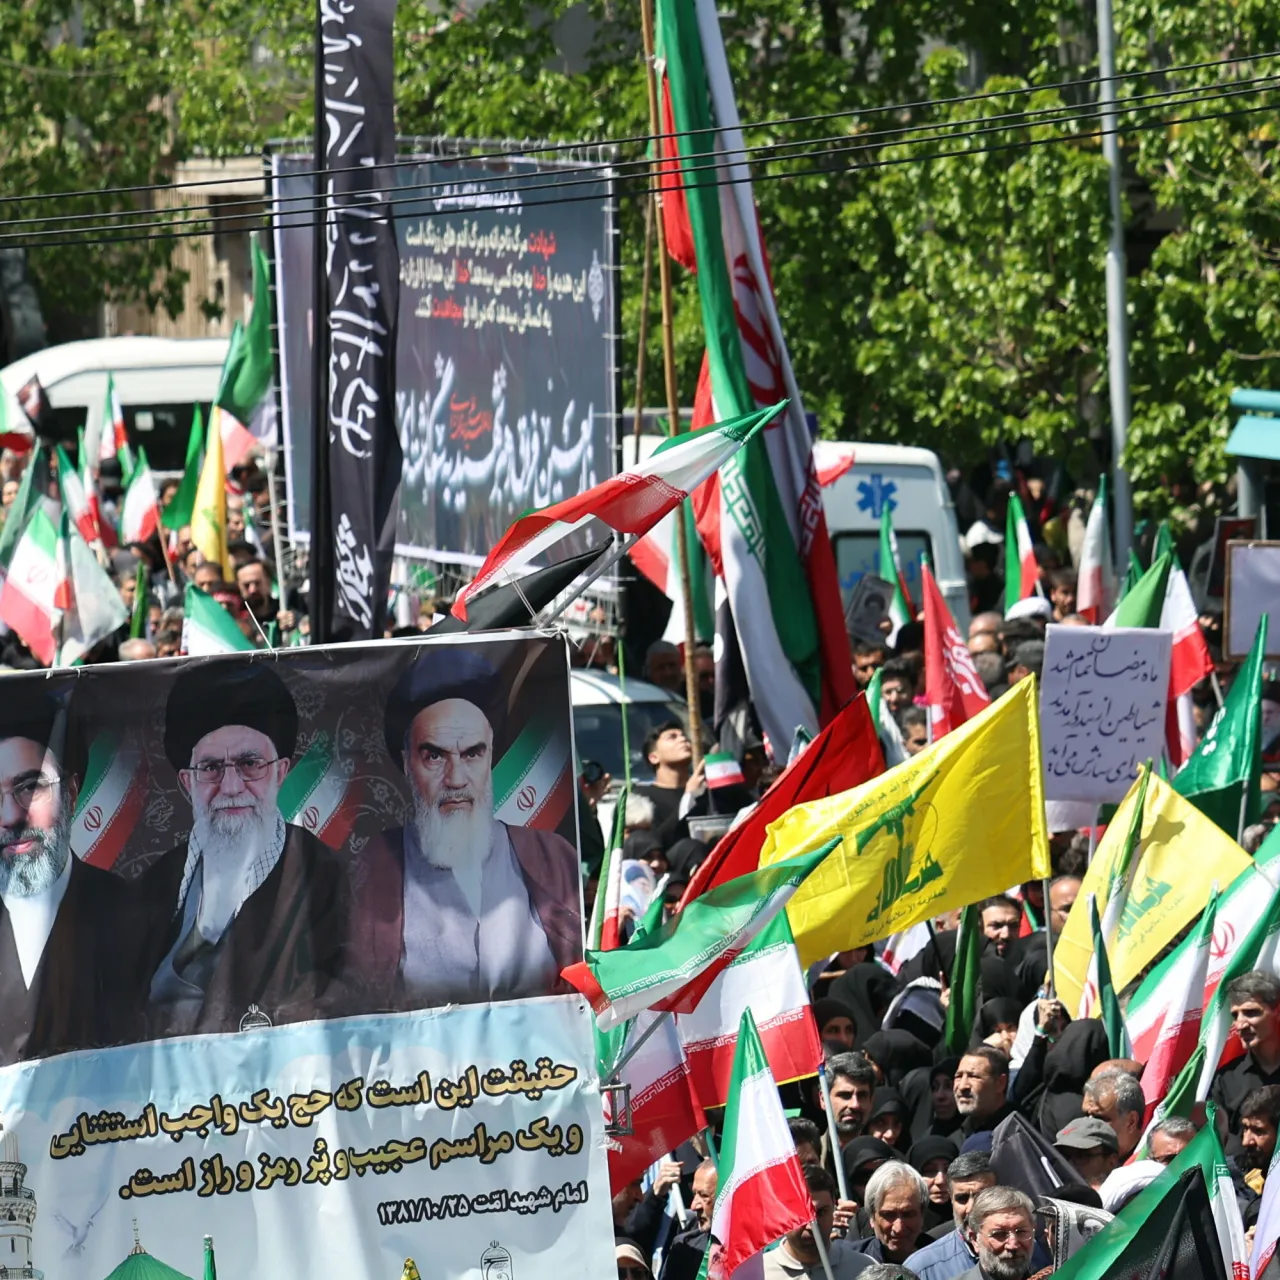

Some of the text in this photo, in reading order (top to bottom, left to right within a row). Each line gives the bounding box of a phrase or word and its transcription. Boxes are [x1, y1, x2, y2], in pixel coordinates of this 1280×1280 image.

[528, 229, 557, 261] شهادت
[456, 259, 469, 284] خدا
[532, 264, 547, 291] خدا
[1091, 636, 1147, 681] رمضان
[1142, 664, 1158, 683] ماه
[1098, 700, 1161, 742] شیاطین
[50, 1057, 577, 1159] حقیقت این است که حج یک واجب استثنایی
[430, 1122, 513, 1169] مراسم
[516, 1116, 564, 1156] یک
[566, 1124, 583, 1153] و
[256, 1151, 301, 1189] رمز
[333, 1149, 349, 1183] و
[349, 1137, 426, 1177] عجیب
[119, 1156, 195, 1199] است.
[197, 1153, 235, 1197] راز
[236, 1160, 255, 1192] و
[377, 1193, 471, 1225] ۱۳۸۱/۱۰/۲۵
[509, 1186, 552, 1214] شهید
[553, 1181, 588, 1212] امام
